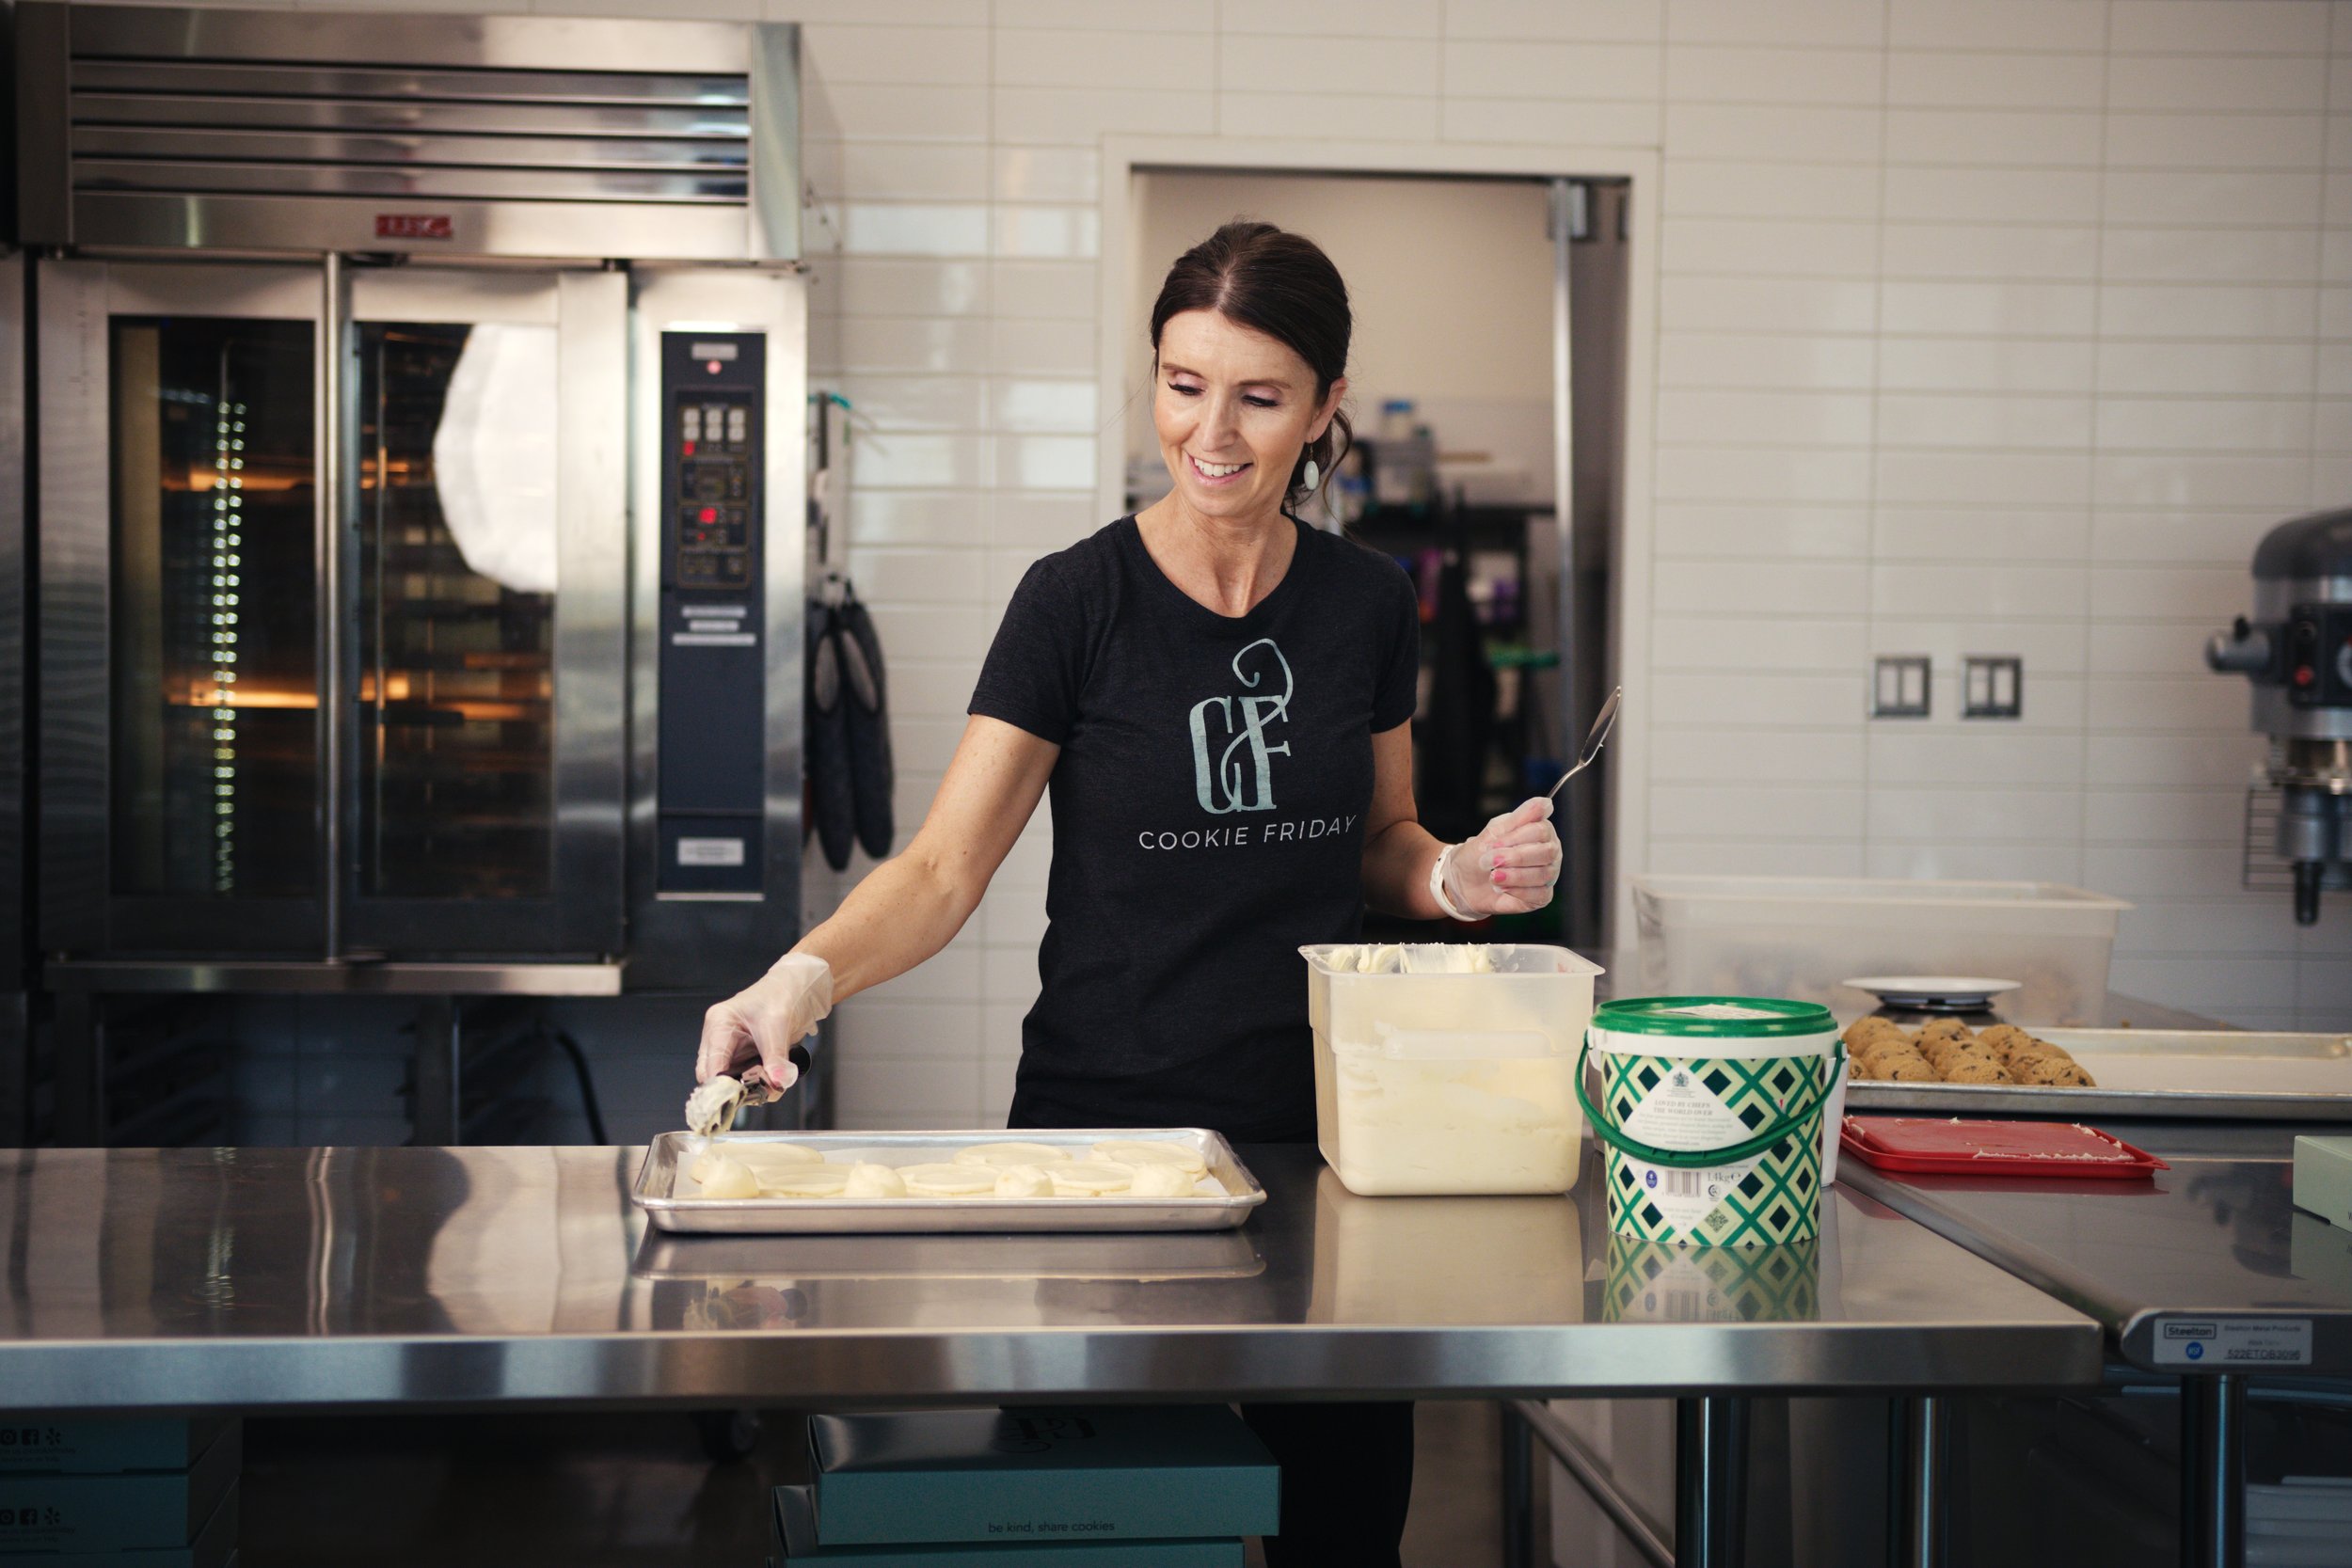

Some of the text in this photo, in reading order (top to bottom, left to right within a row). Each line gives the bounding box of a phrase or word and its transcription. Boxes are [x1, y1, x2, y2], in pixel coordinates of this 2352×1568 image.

[1138, 815, 1357, 849] COOKIE FRIDAY
[1655, 1100, 1677, 1108] LOVED
[2168, 1326, 2213, 1337] Steelton
[988, 1520, 1115, 1534] be kind, share cookies
